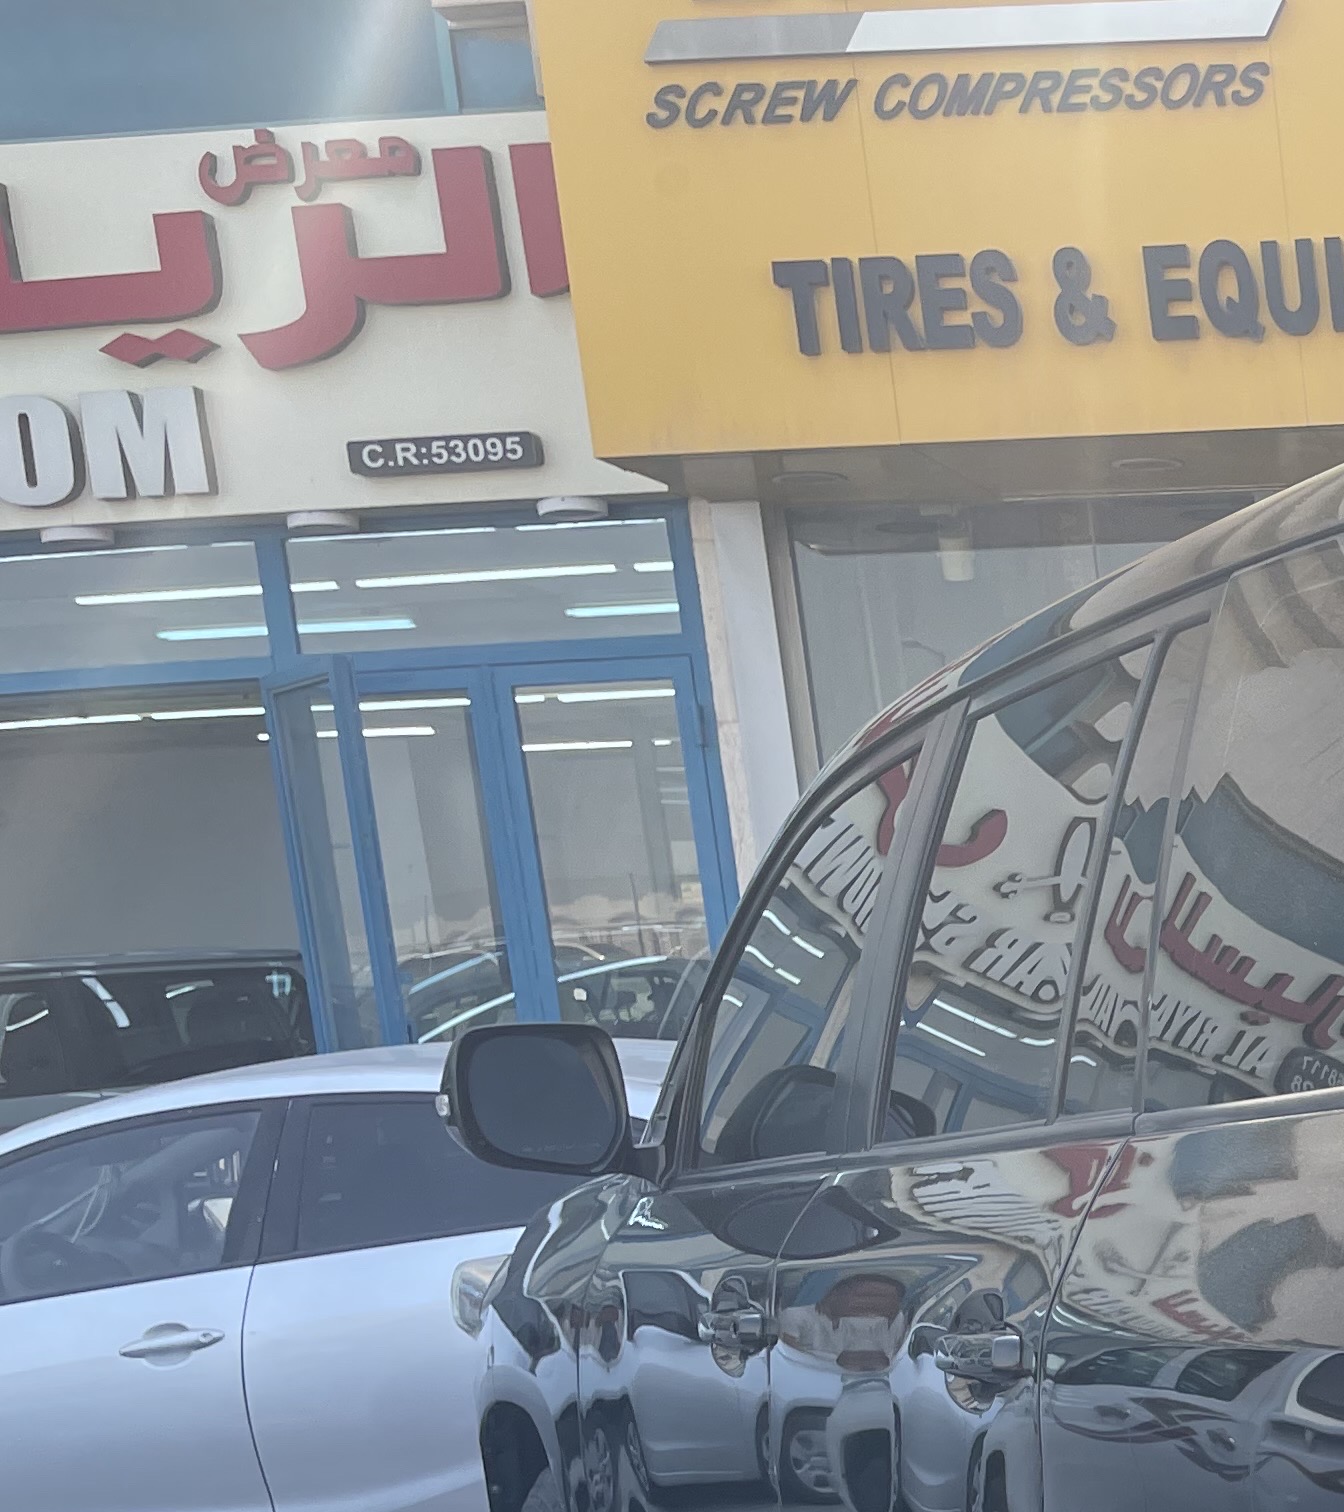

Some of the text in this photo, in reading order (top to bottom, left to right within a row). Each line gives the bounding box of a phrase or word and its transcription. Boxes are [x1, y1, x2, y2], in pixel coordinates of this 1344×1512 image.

[645, 62, 1271, 129] SCREW COMPRESSORS
[199, 128, 422, 206] معرض
[772, 249, 1024, 357] TIRES
[1052, 246, 1117, 348] &
[361, 436, 524, 469] C.R:53095
